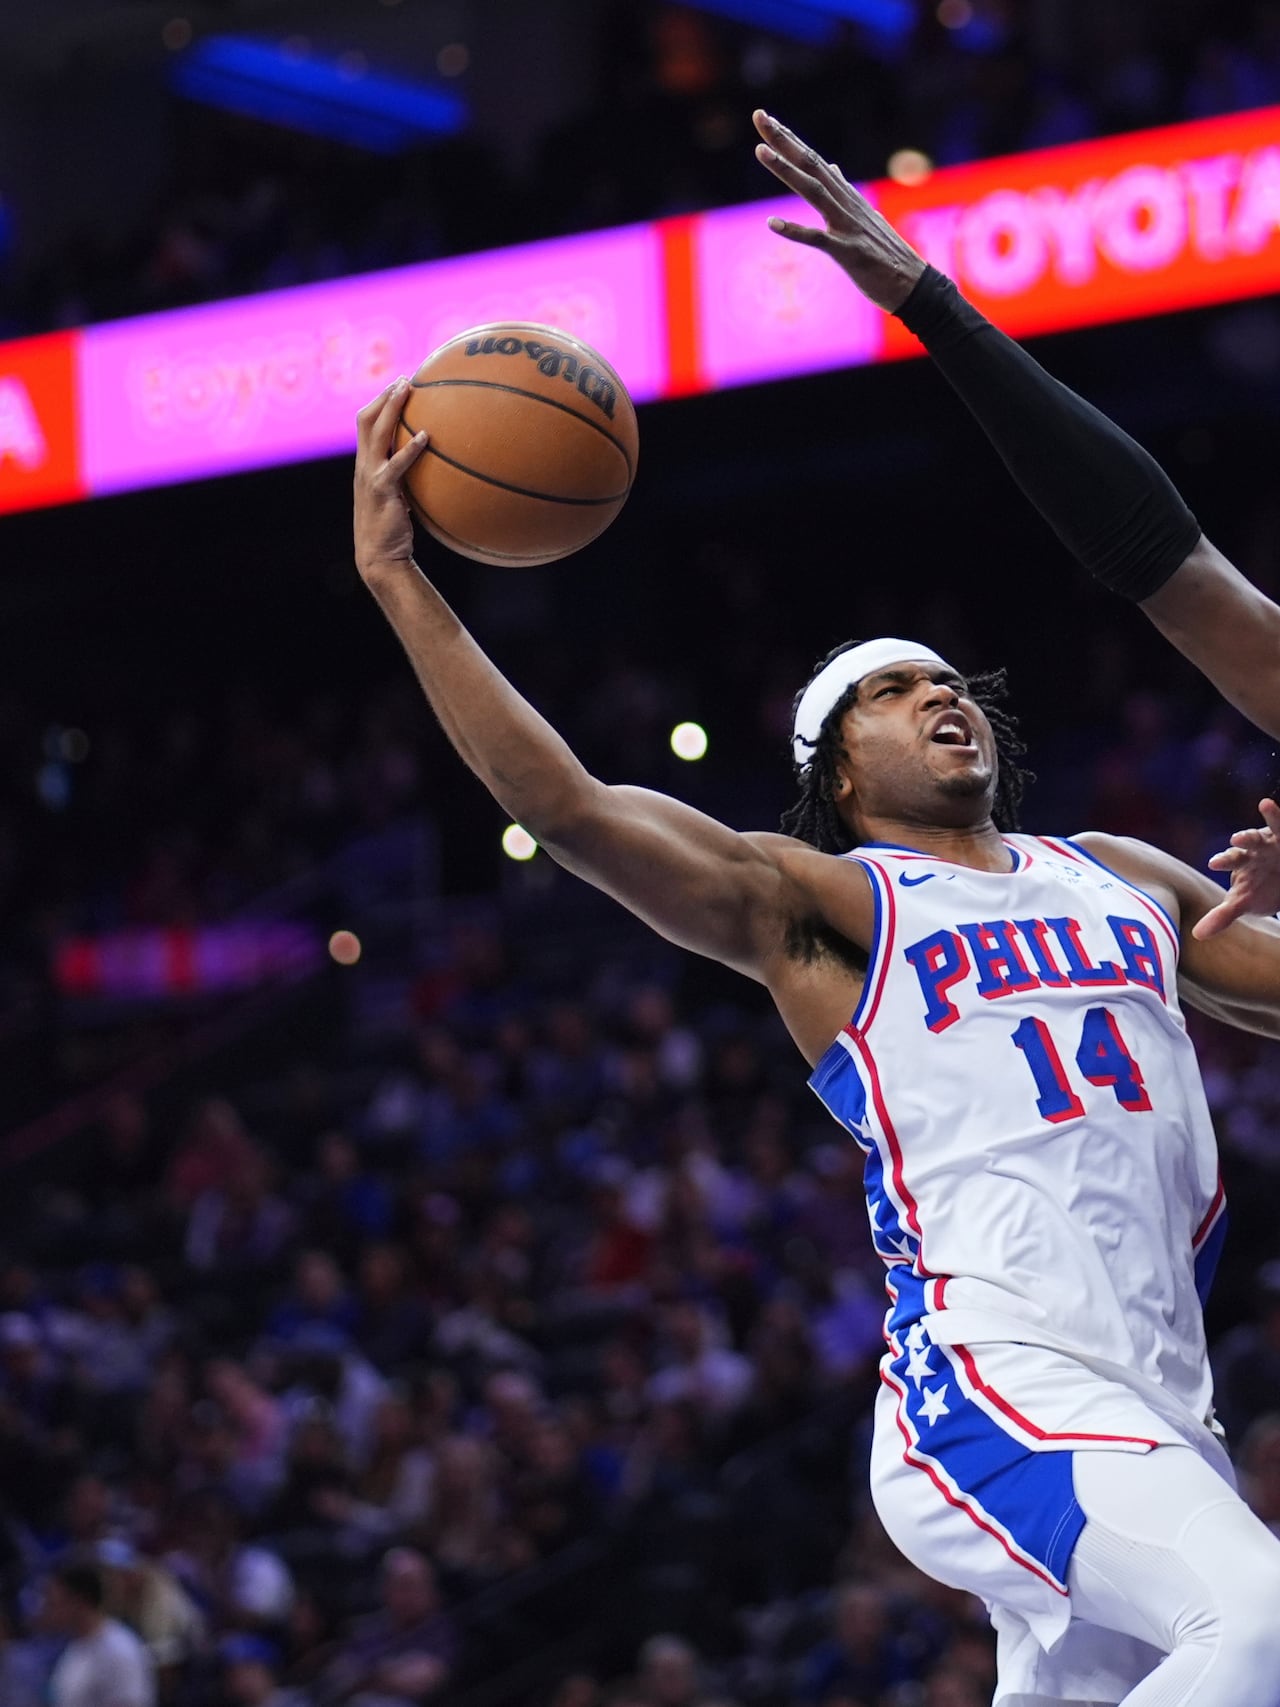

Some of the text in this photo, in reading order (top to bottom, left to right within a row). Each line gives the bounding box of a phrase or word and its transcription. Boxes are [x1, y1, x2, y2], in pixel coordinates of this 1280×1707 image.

[463, 336, 617, 422] Wilson
[904, 914, 1168, 1034] PHILA
[1010, 1006, 1153, 1124] 14
